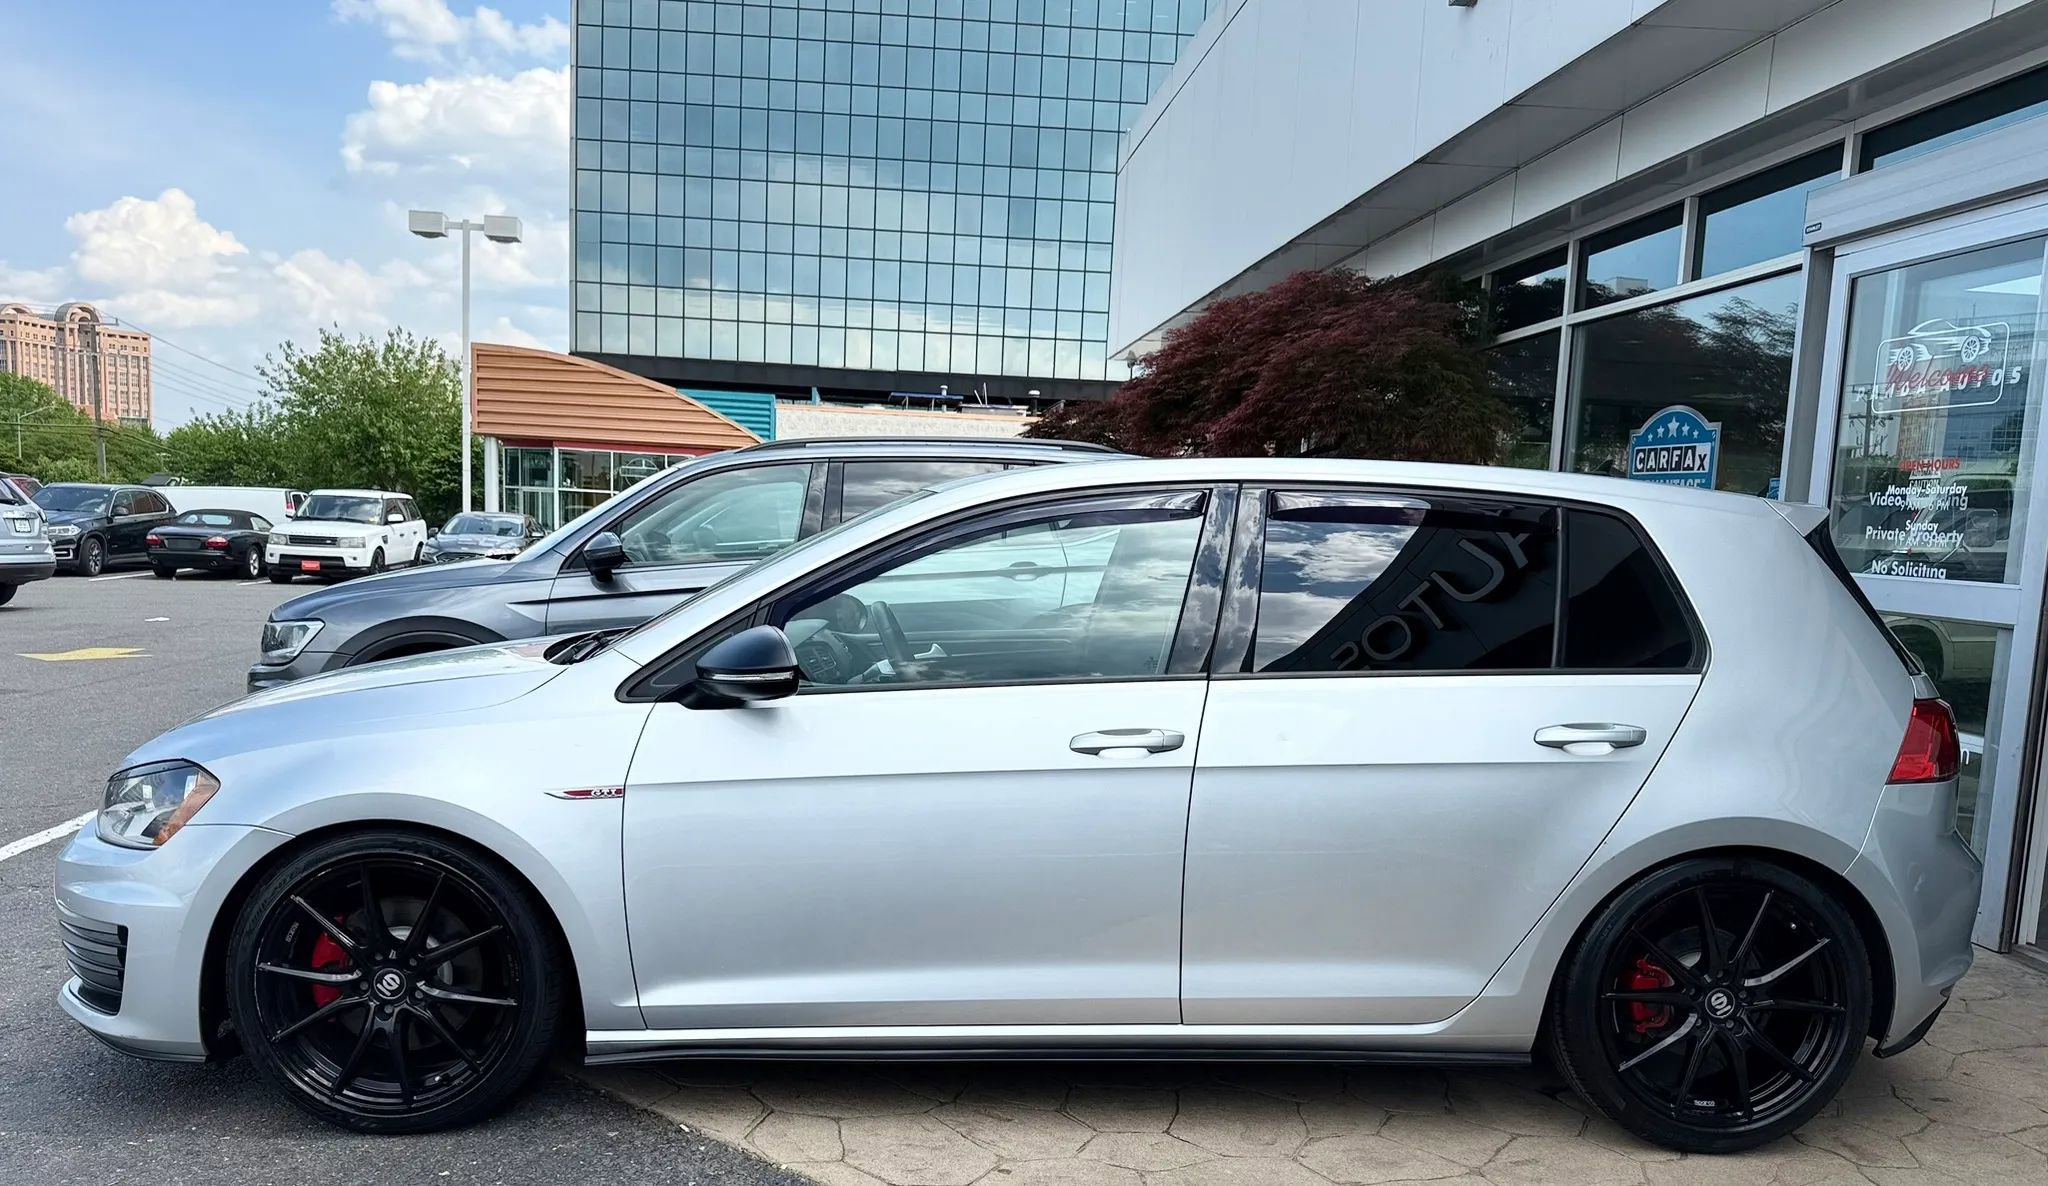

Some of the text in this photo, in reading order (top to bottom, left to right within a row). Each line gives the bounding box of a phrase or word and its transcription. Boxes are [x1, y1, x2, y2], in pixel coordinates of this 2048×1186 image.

[1636, 449, 1707, 471] CARFAX
[1926, 458, 1961, 470] HOURS
[1887, 482, 1968, 497] Monday-Saturday
[1869, 492, 1901, 507] Video
[1905, 520, 1939, 534] Sunday
[1865, 526, 1964, 548] Private Property
[1871, 560, 1888, 574] No
[591, 788, 616, 797] GTI
